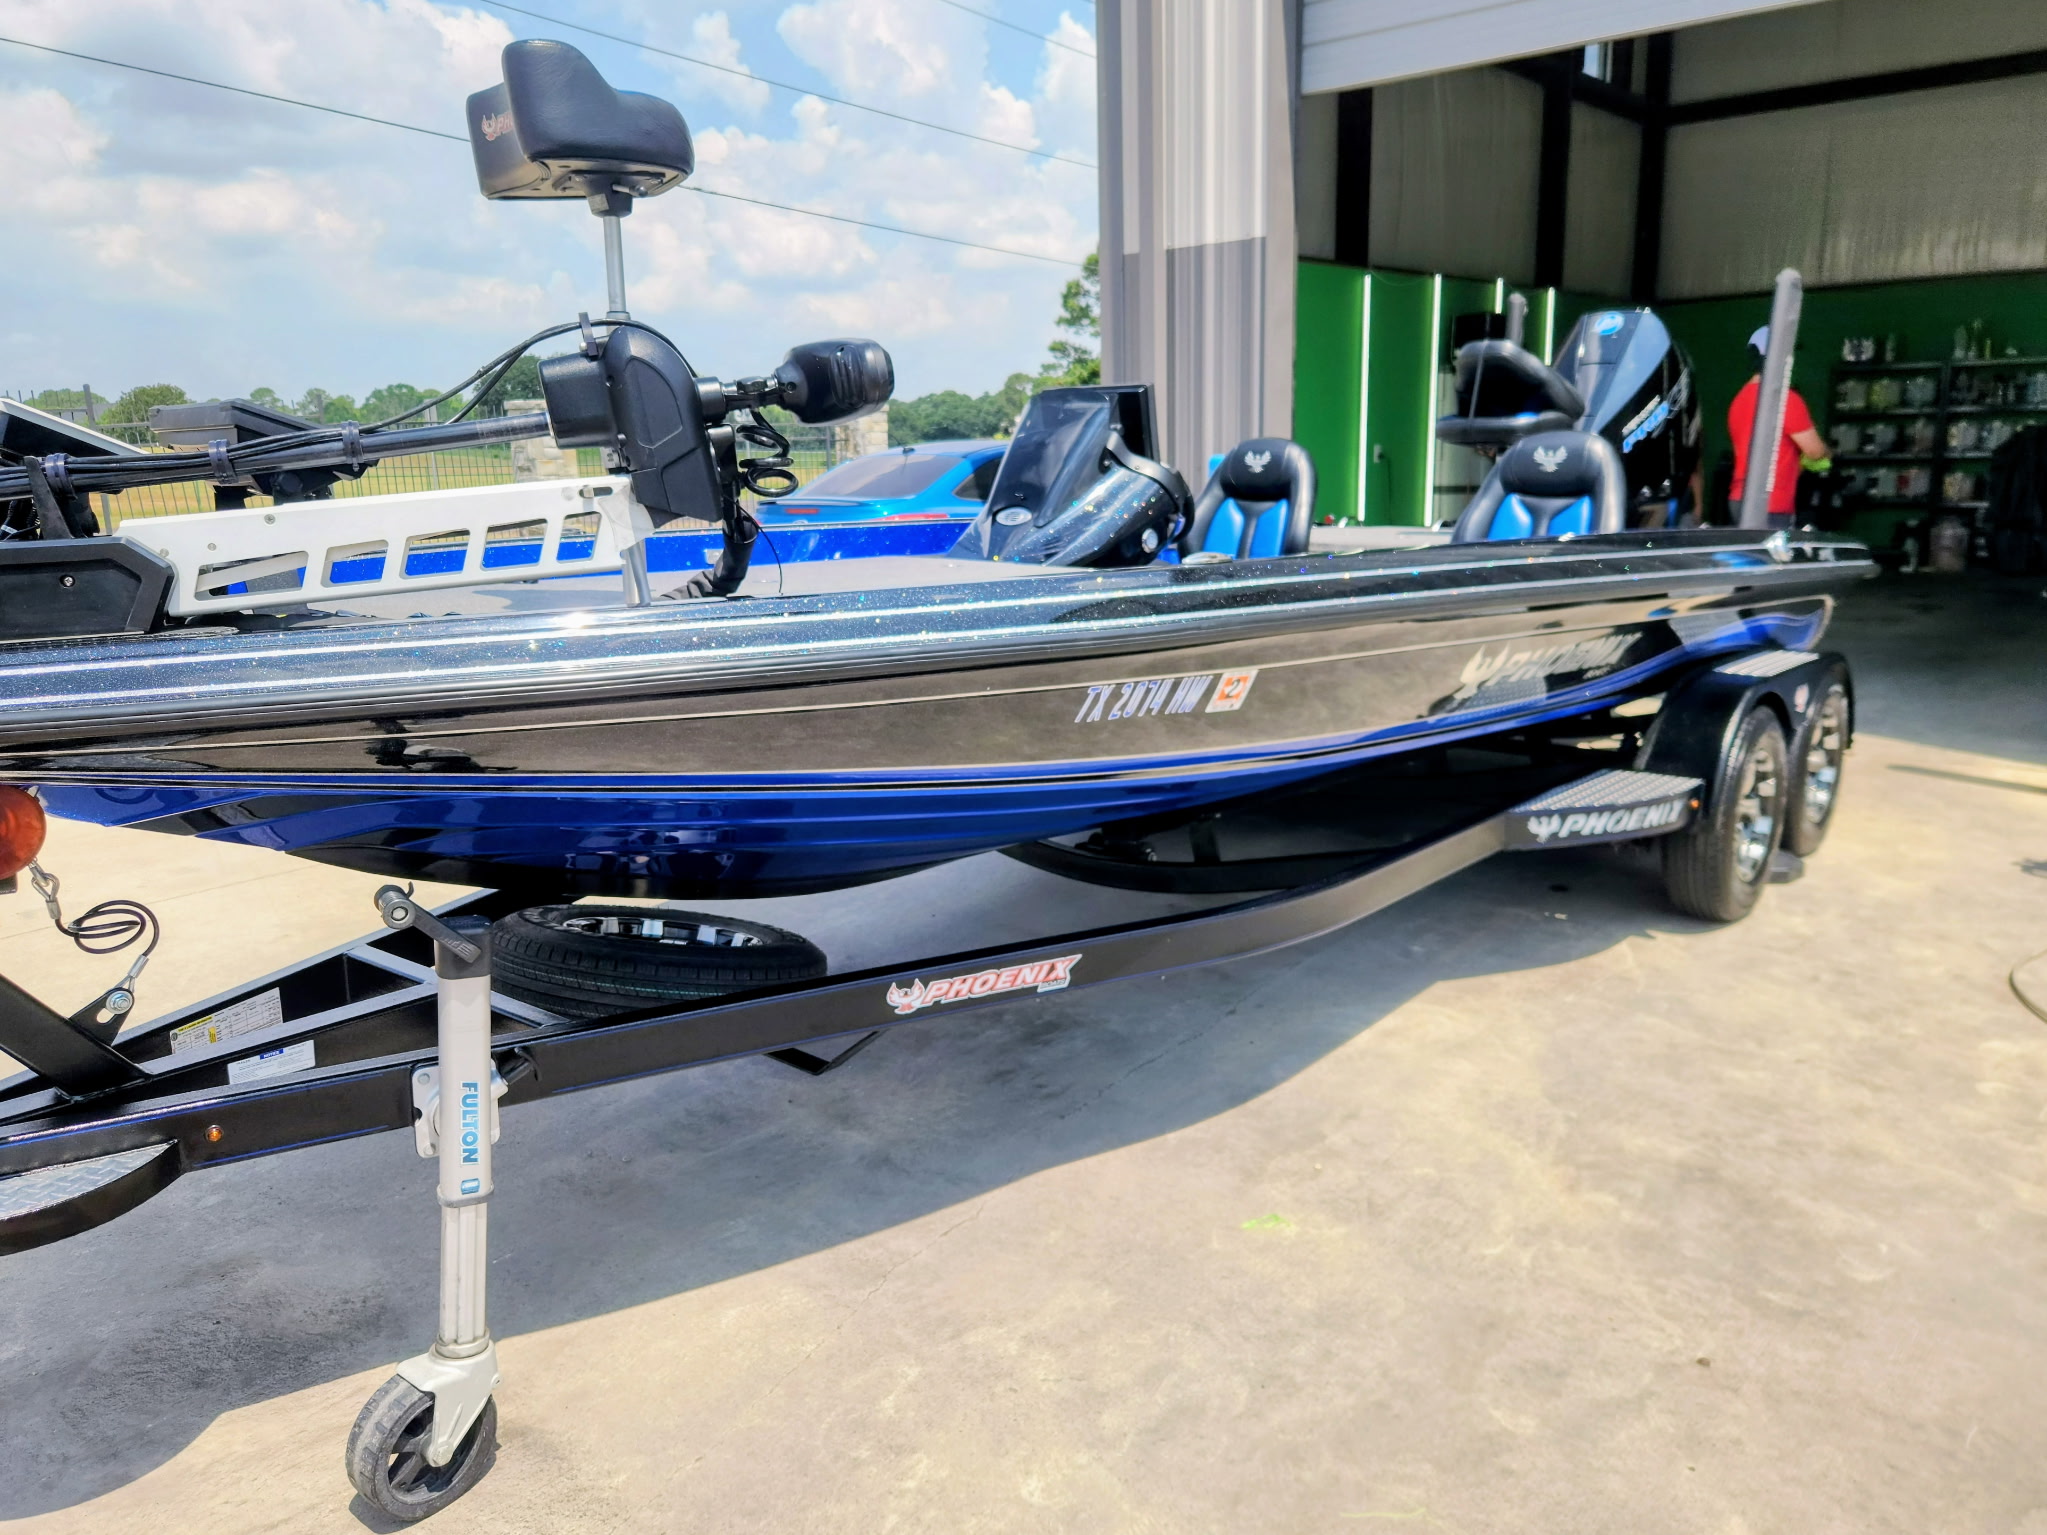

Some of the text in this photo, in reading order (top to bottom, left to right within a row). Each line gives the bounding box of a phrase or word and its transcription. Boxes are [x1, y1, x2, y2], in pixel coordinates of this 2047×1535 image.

[1074, 685, 1116, 723] TX
[1108, 679, 1175, 720] 2074
[1558, 799, 1686, 838] PHOENIX
[920, 956, 1081, 1005] PHOENIX
[461, 1082, 479, 1164] FULTON
